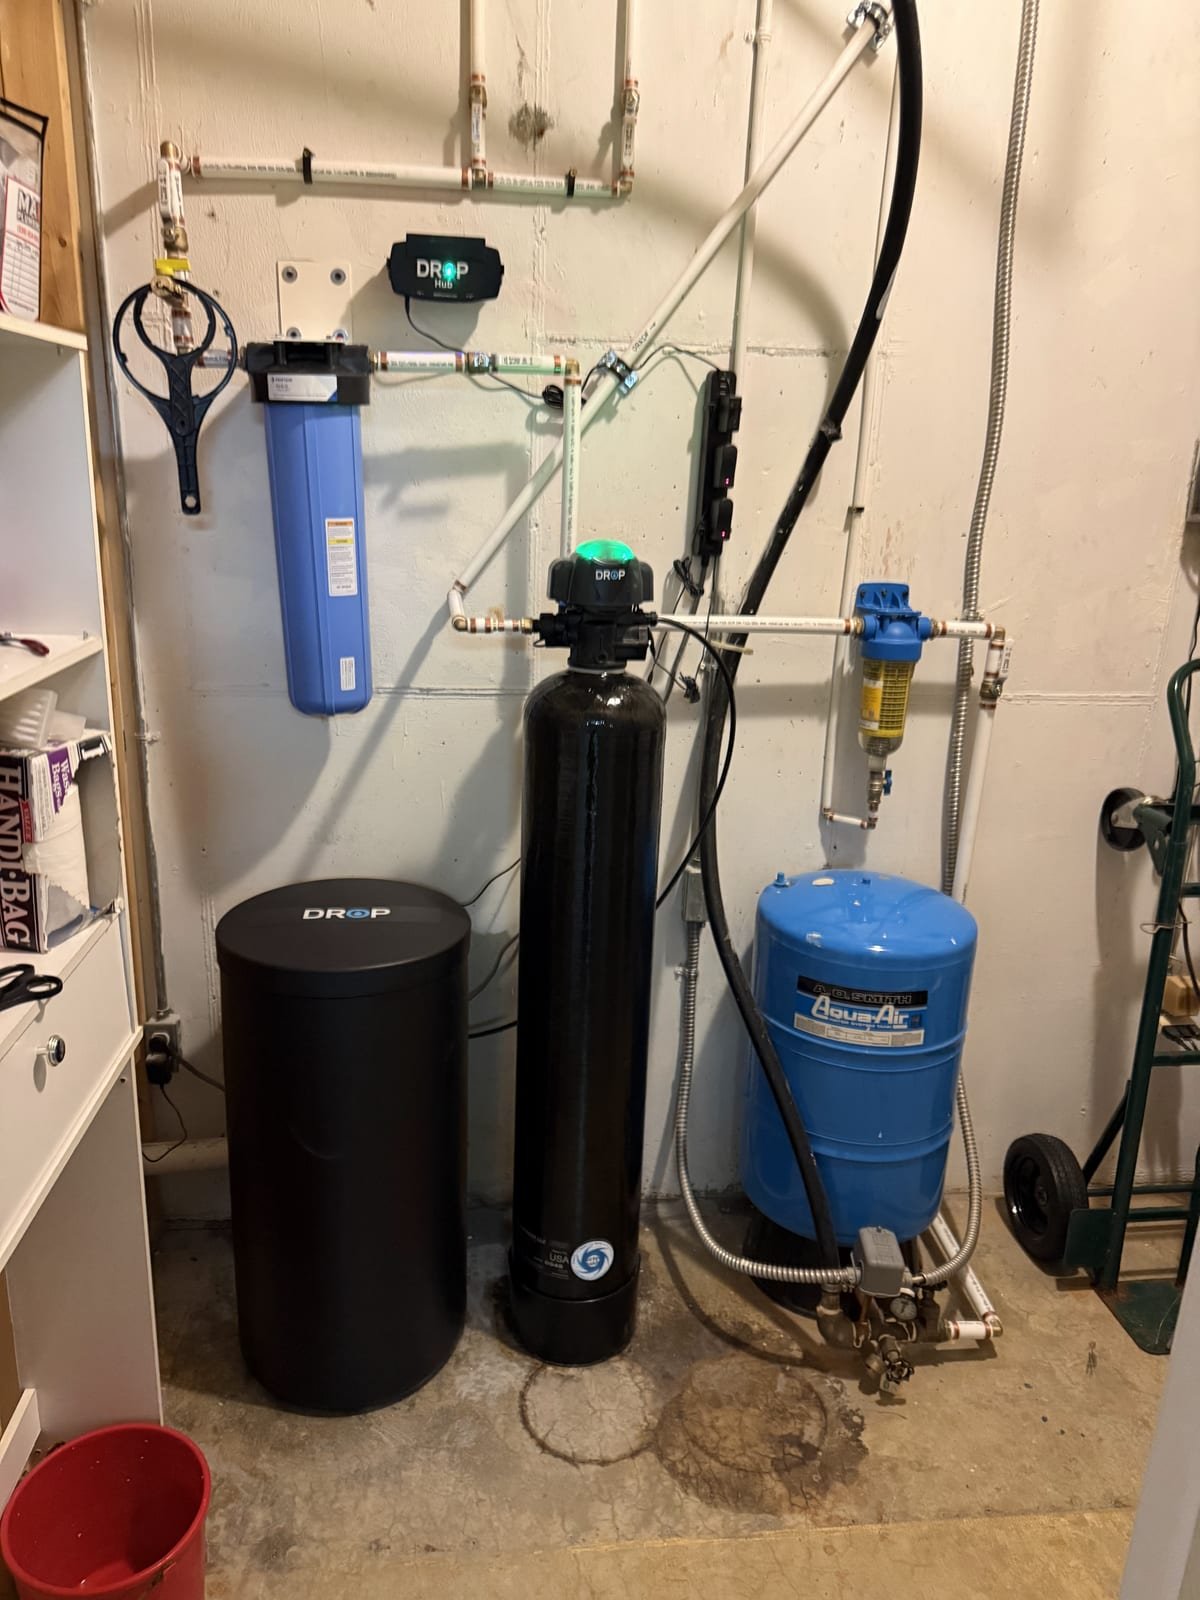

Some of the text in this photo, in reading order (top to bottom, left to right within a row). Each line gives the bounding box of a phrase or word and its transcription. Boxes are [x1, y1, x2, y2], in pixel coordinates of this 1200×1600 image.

[416, 258, 470, 280] DROP
[434, 279, 453, 289] Hub
[595, 569, 626, 581] DROP
[60, 758, 72, 796] Was
[302, 907, 392, 920] DROP
